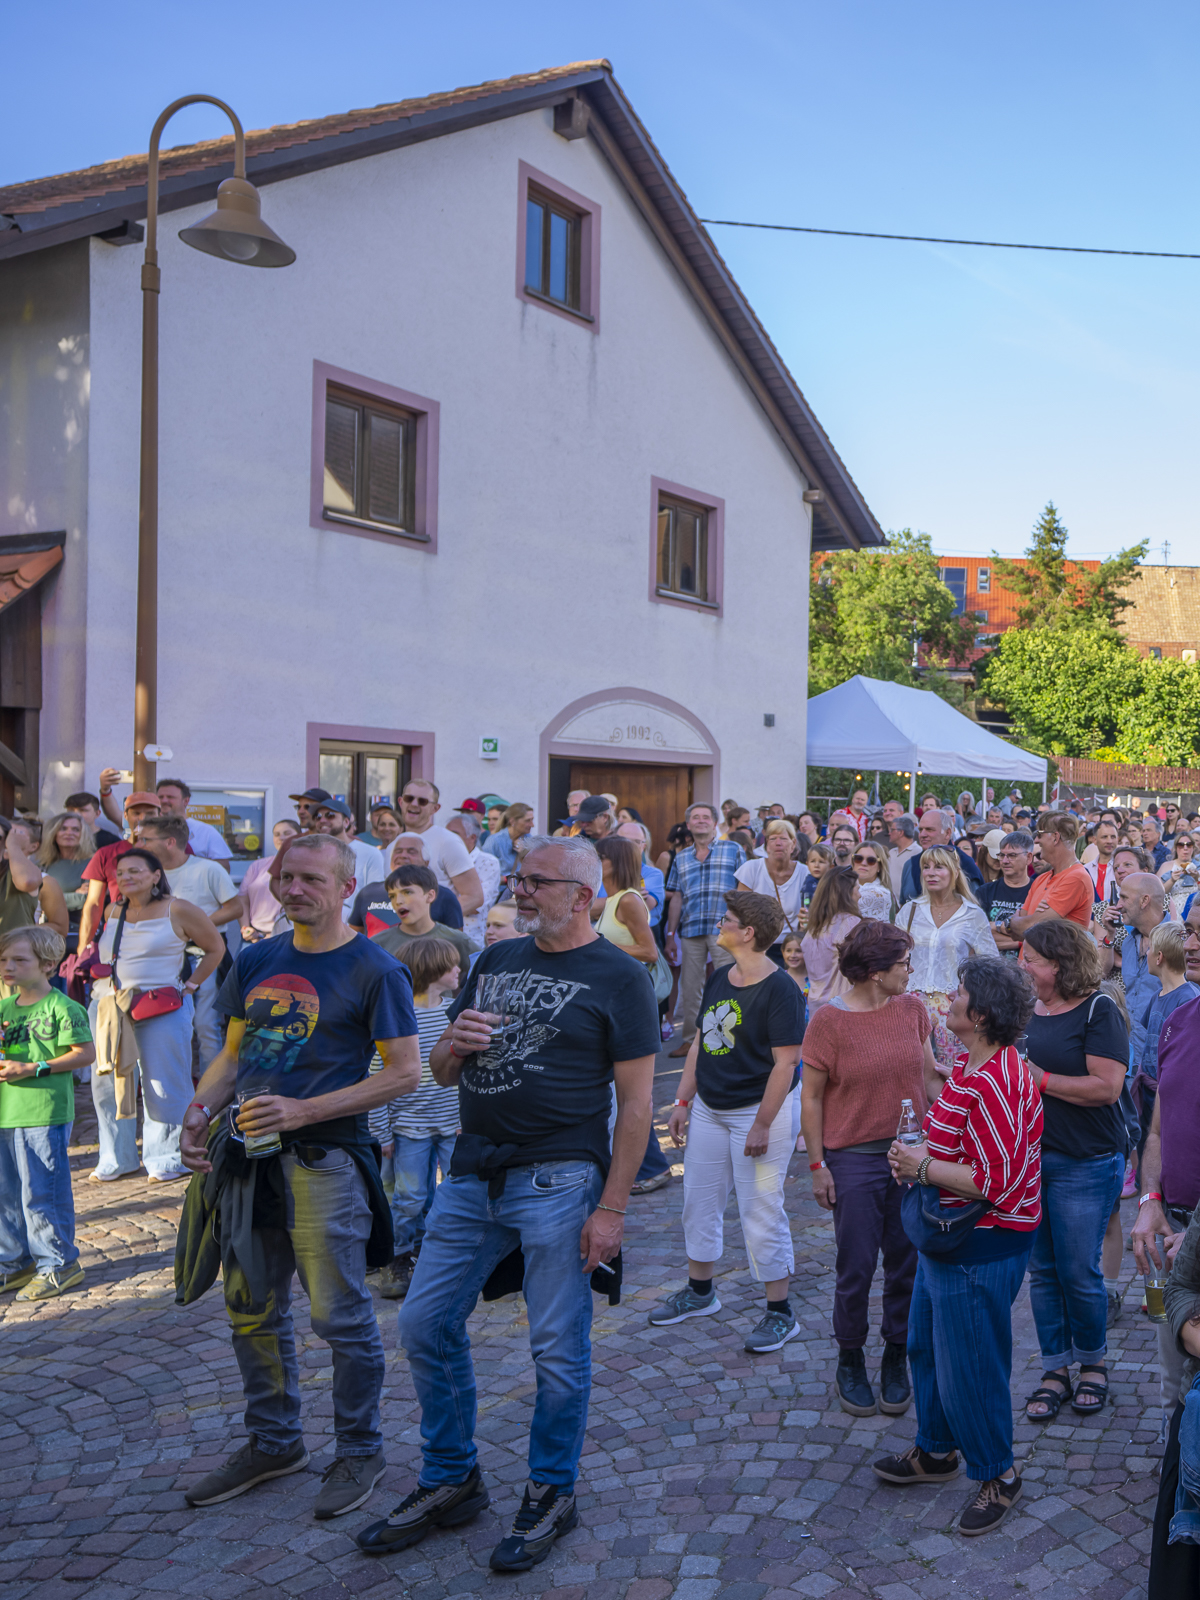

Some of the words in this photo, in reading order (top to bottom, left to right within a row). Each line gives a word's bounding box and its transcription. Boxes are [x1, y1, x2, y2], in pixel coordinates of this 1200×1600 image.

[626, 725, 651, 740] 1992
[991, 900, 1025, 909] STAHLZ
[477, 1078, 522, 1095] WORLD
